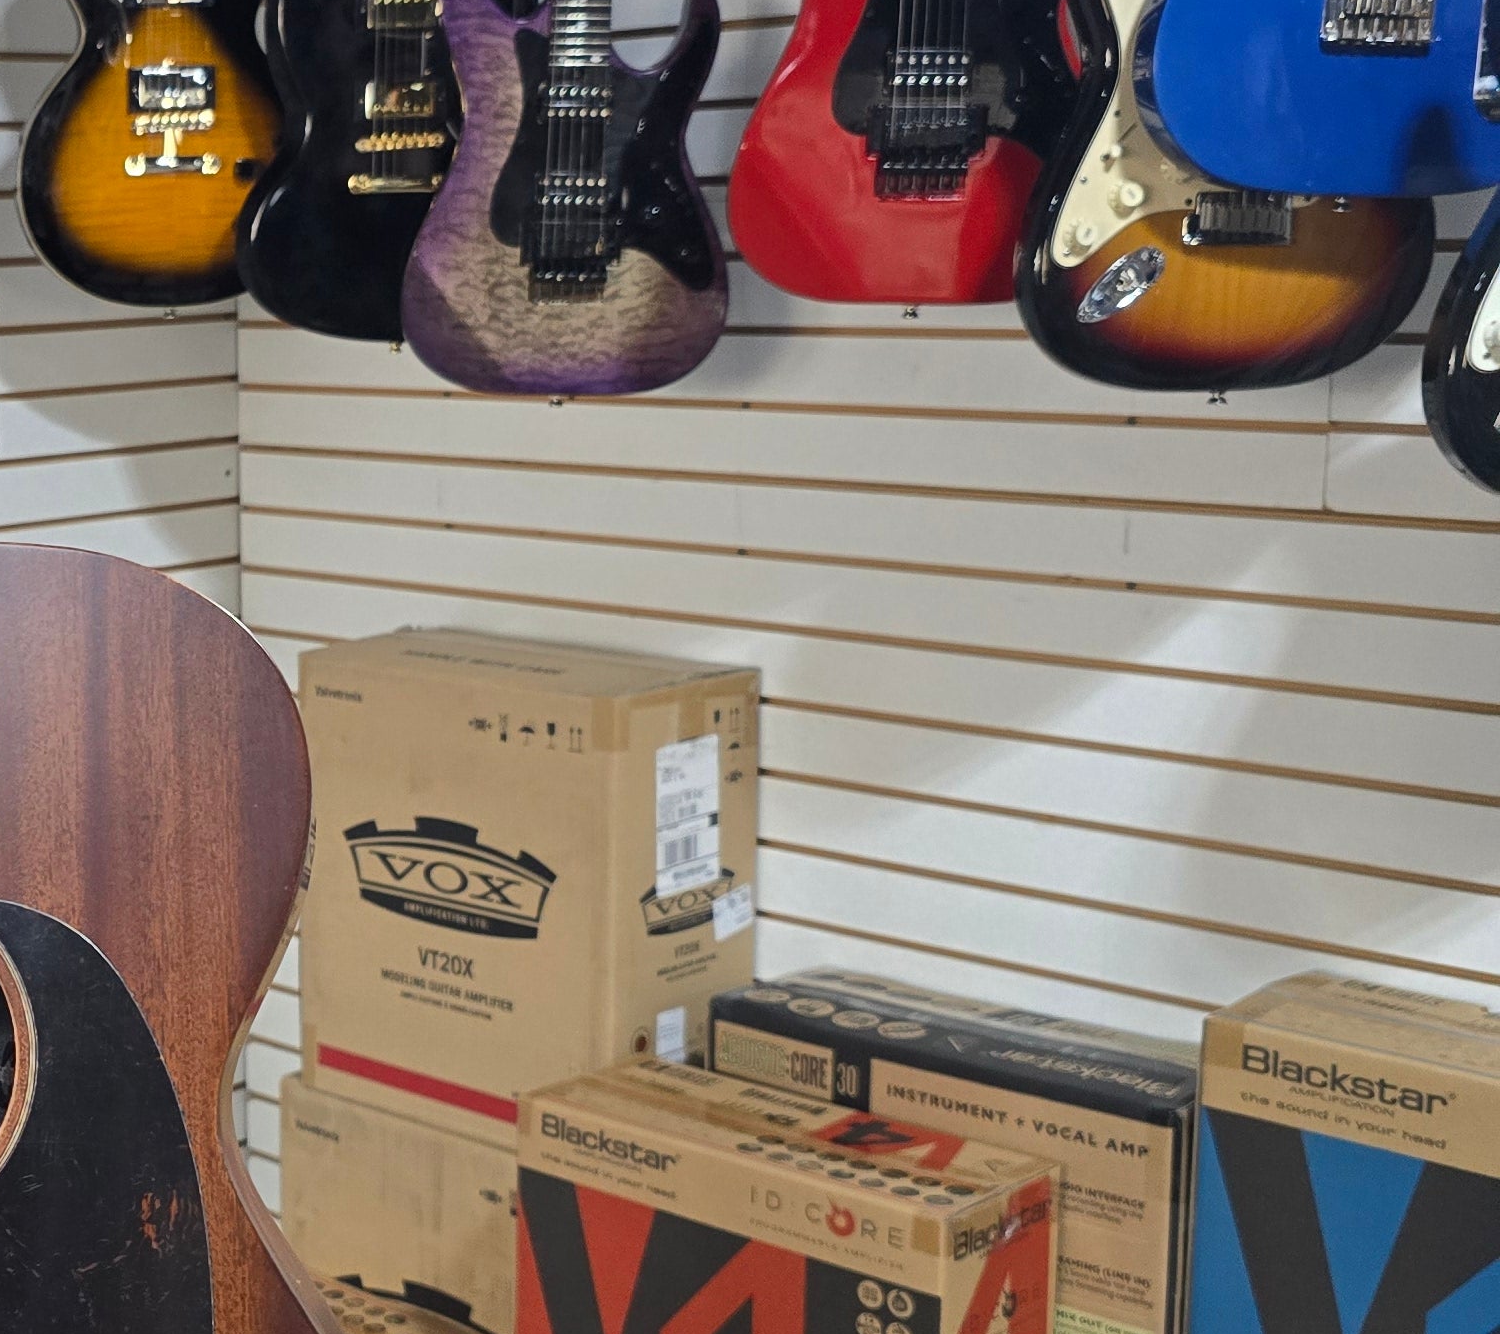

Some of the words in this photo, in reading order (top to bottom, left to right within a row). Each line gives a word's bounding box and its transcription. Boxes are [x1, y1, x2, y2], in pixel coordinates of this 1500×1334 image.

[368, 849, 522, 910] VOX
[417, 945, 474, 979] VT20X
[835, 1063, 860, 1098] 30
[1240, 1043, 1448, 1115] Blackstar
[540, 1112, 676, 1173] Blackstar
[886, 1082, 1009, 1124] INSTRUMENT
[1031, 1118, 1098, 1149] VOCAL
[1104, 1134, 1151, 1159] AMP
[1355, 1119, 1397, 1138] your
